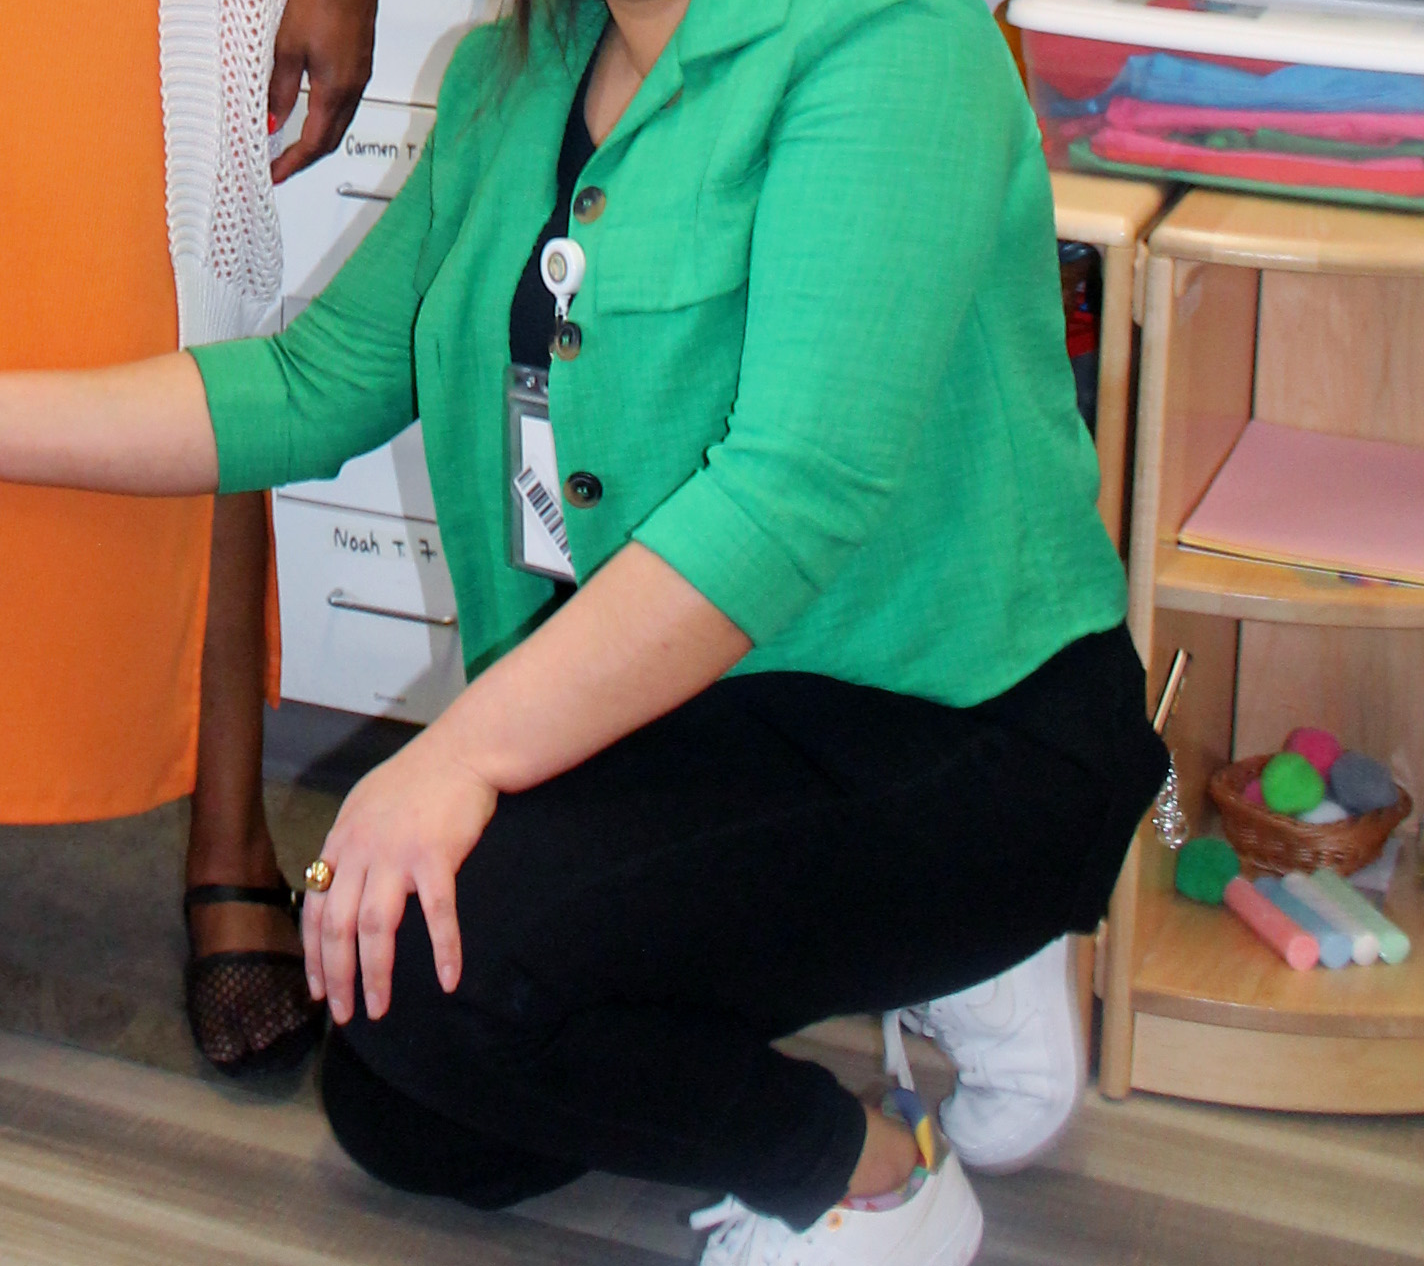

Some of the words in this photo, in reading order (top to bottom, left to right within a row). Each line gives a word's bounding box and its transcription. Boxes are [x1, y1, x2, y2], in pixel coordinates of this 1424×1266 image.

[346, 134, 398, 159] Carmen
[335, 527, 380, 555] Noah
[419, 538, 437, 563] 7
